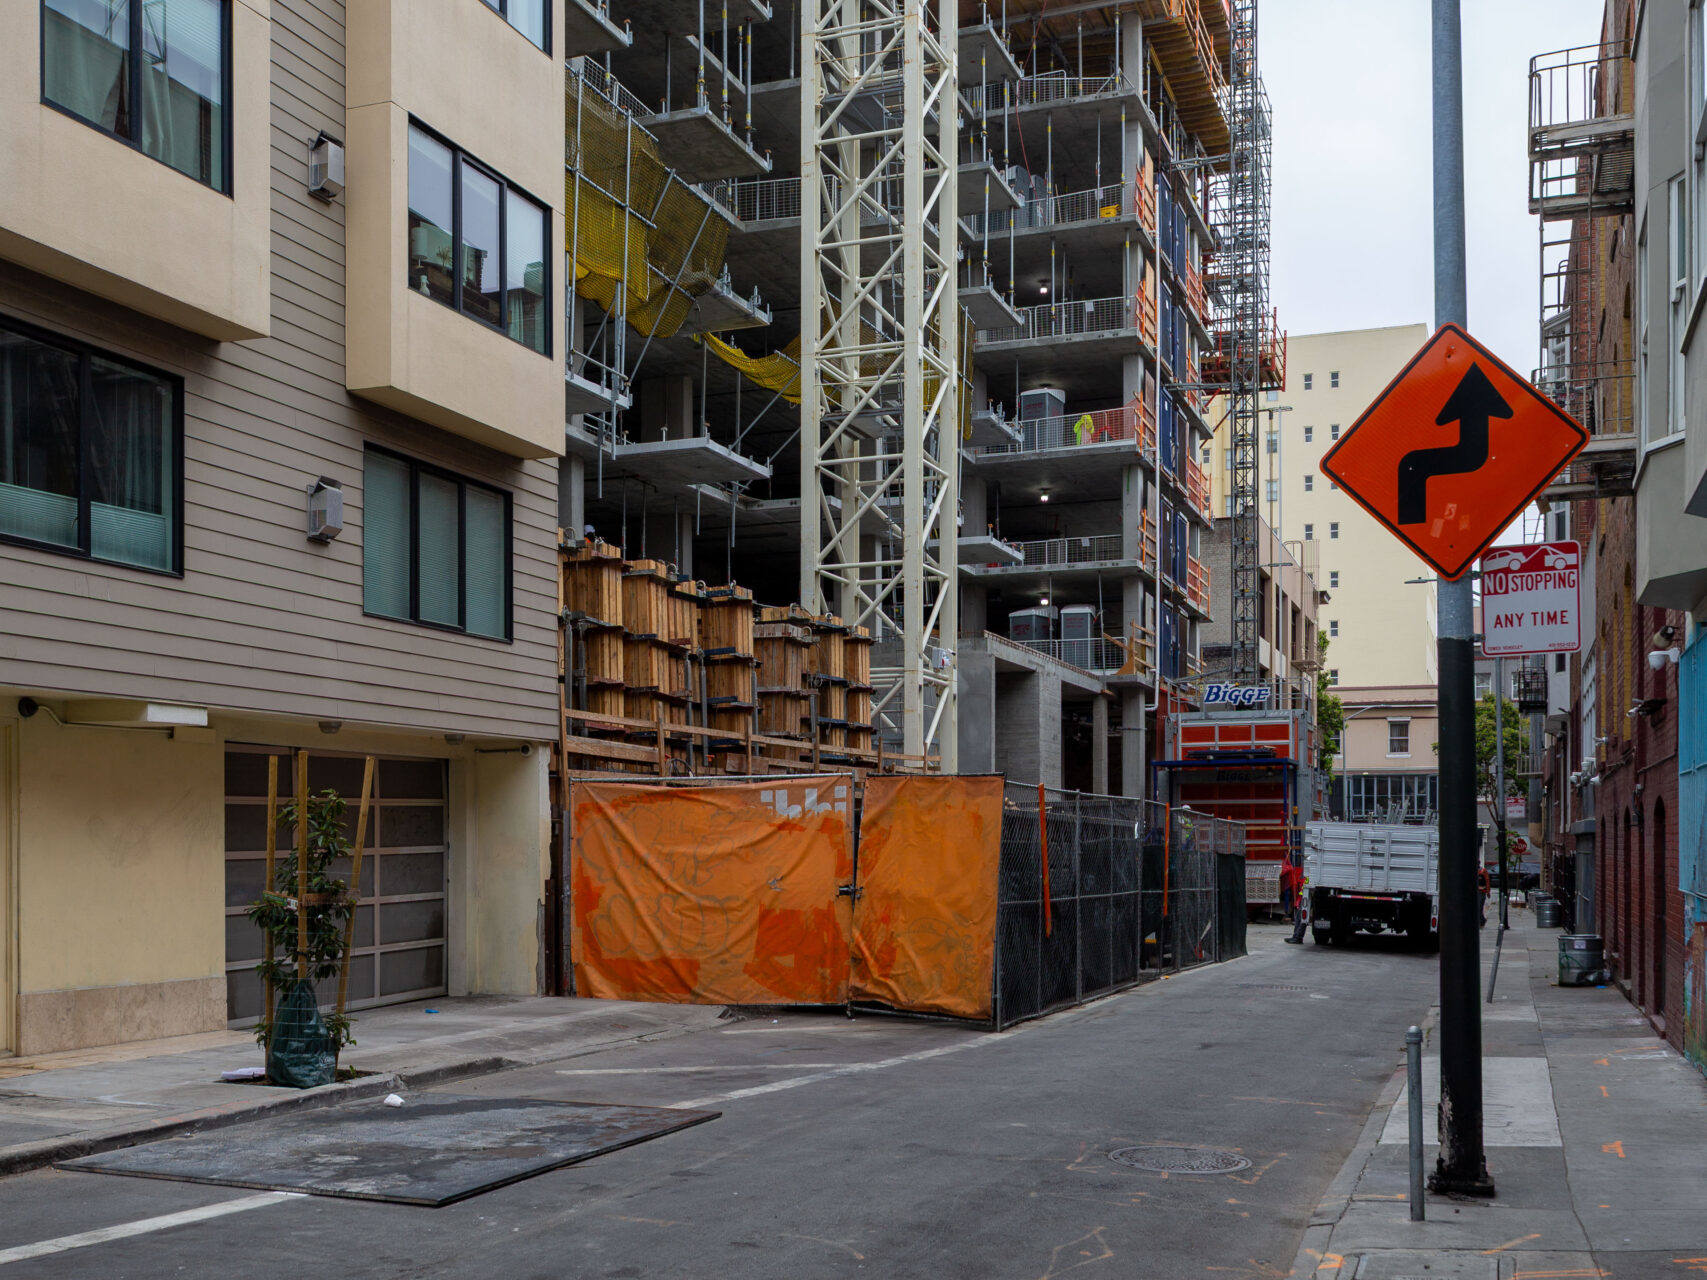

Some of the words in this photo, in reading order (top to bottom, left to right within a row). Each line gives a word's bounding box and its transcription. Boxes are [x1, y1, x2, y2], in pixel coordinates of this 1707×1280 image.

[1484, 572, 1507, 594] NO
[1511, 571, 1576, 592] STOPPING
[1494, 612, 1525, 629] ANY
[1531, 610, 1569, 626] TIME
